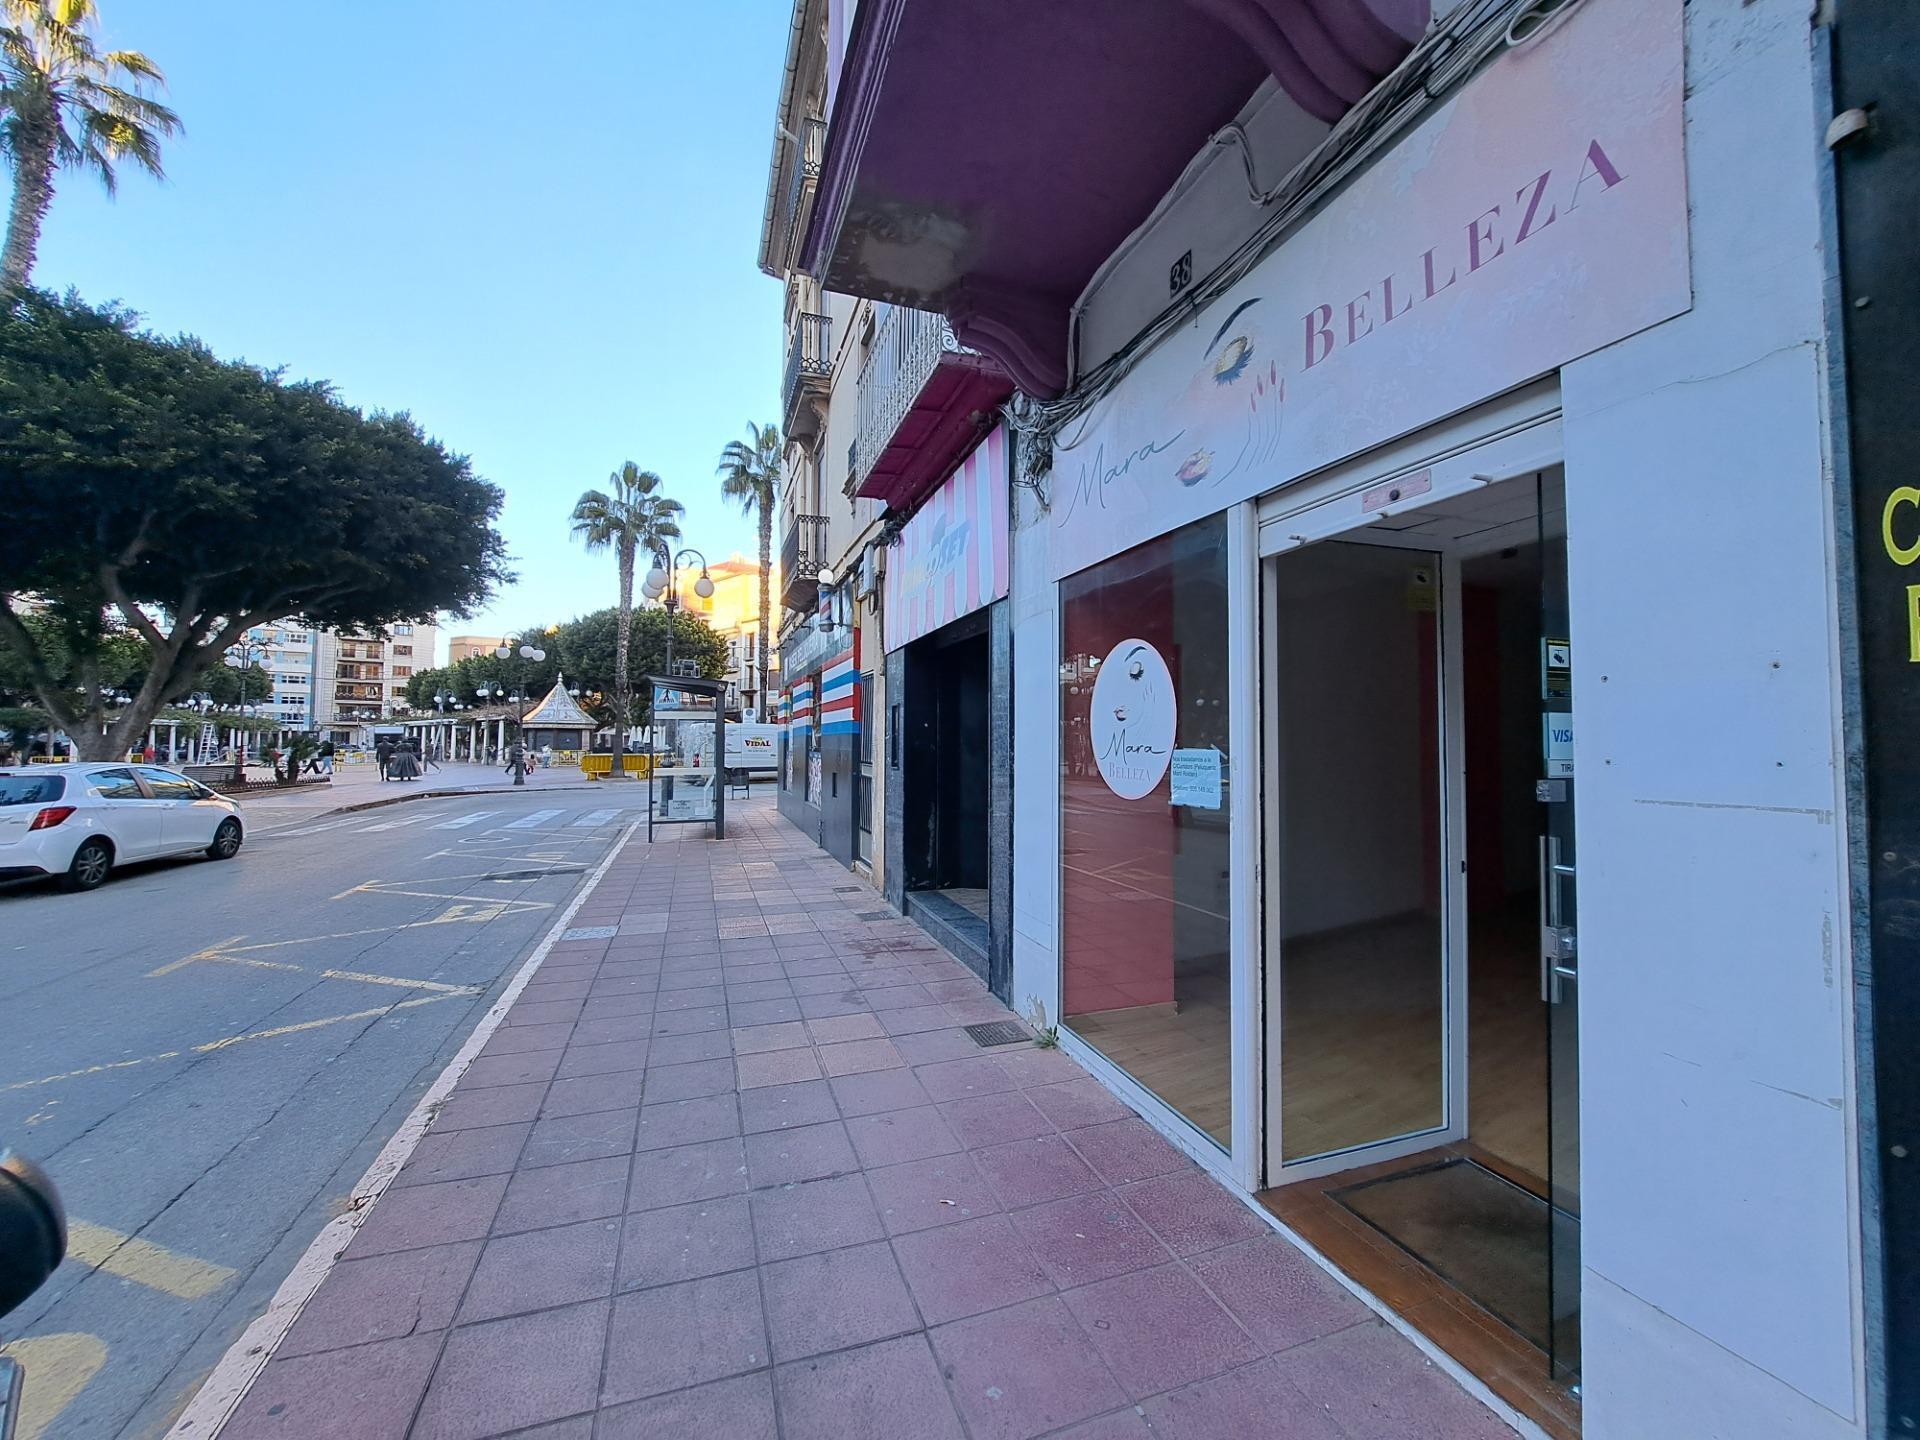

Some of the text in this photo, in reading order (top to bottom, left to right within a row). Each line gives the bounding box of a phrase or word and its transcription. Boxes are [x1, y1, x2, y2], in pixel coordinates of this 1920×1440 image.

[1171, 253, 1191, 295] 38
[1300, 139, 1629, 373] BELLEZA
[1058, 429, 1186, 528] Mara
[745, 739, 771, 747] VIDAL
[1100, 728, 1167, 766] Mara
[1109, 762, 1151, 782] BELLEZA
